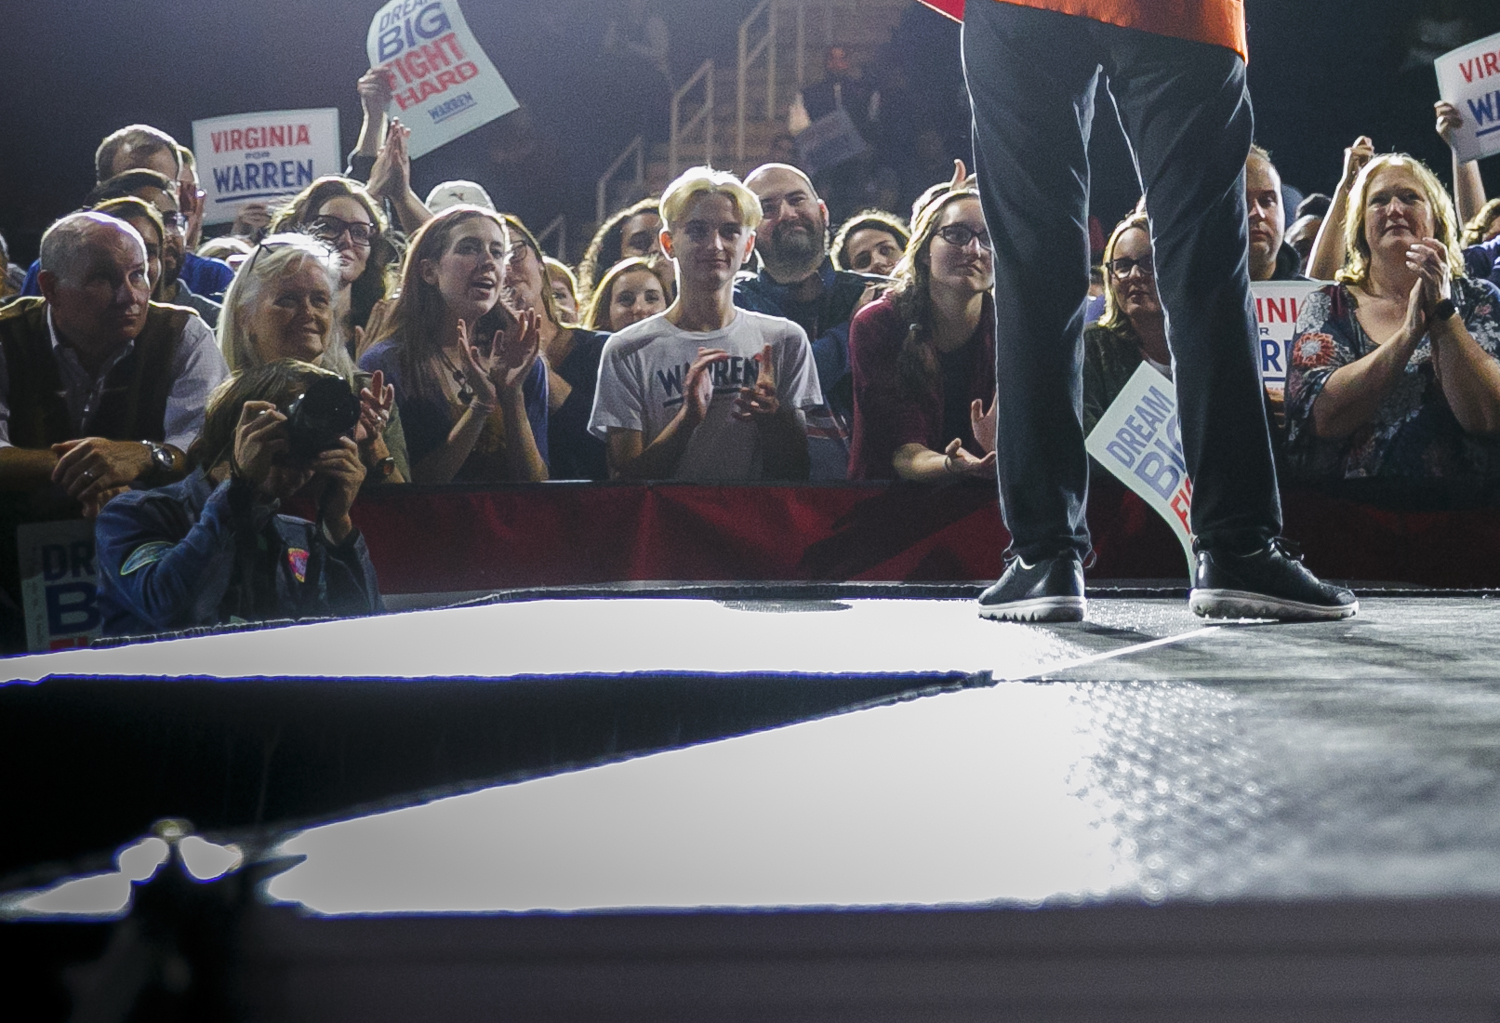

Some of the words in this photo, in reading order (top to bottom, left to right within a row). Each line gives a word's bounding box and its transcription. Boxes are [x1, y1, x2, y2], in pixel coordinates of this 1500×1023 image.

[378, 2, 451, 63] BIG
[393, 61, 479, 111] HARD
[428, 92, 474, 120] WARREN
[211, 124, 311, 154] VIRGINIA
[213, 159, 313, 193] WARREN
[1106, 385, 1175, 469] DREAM
